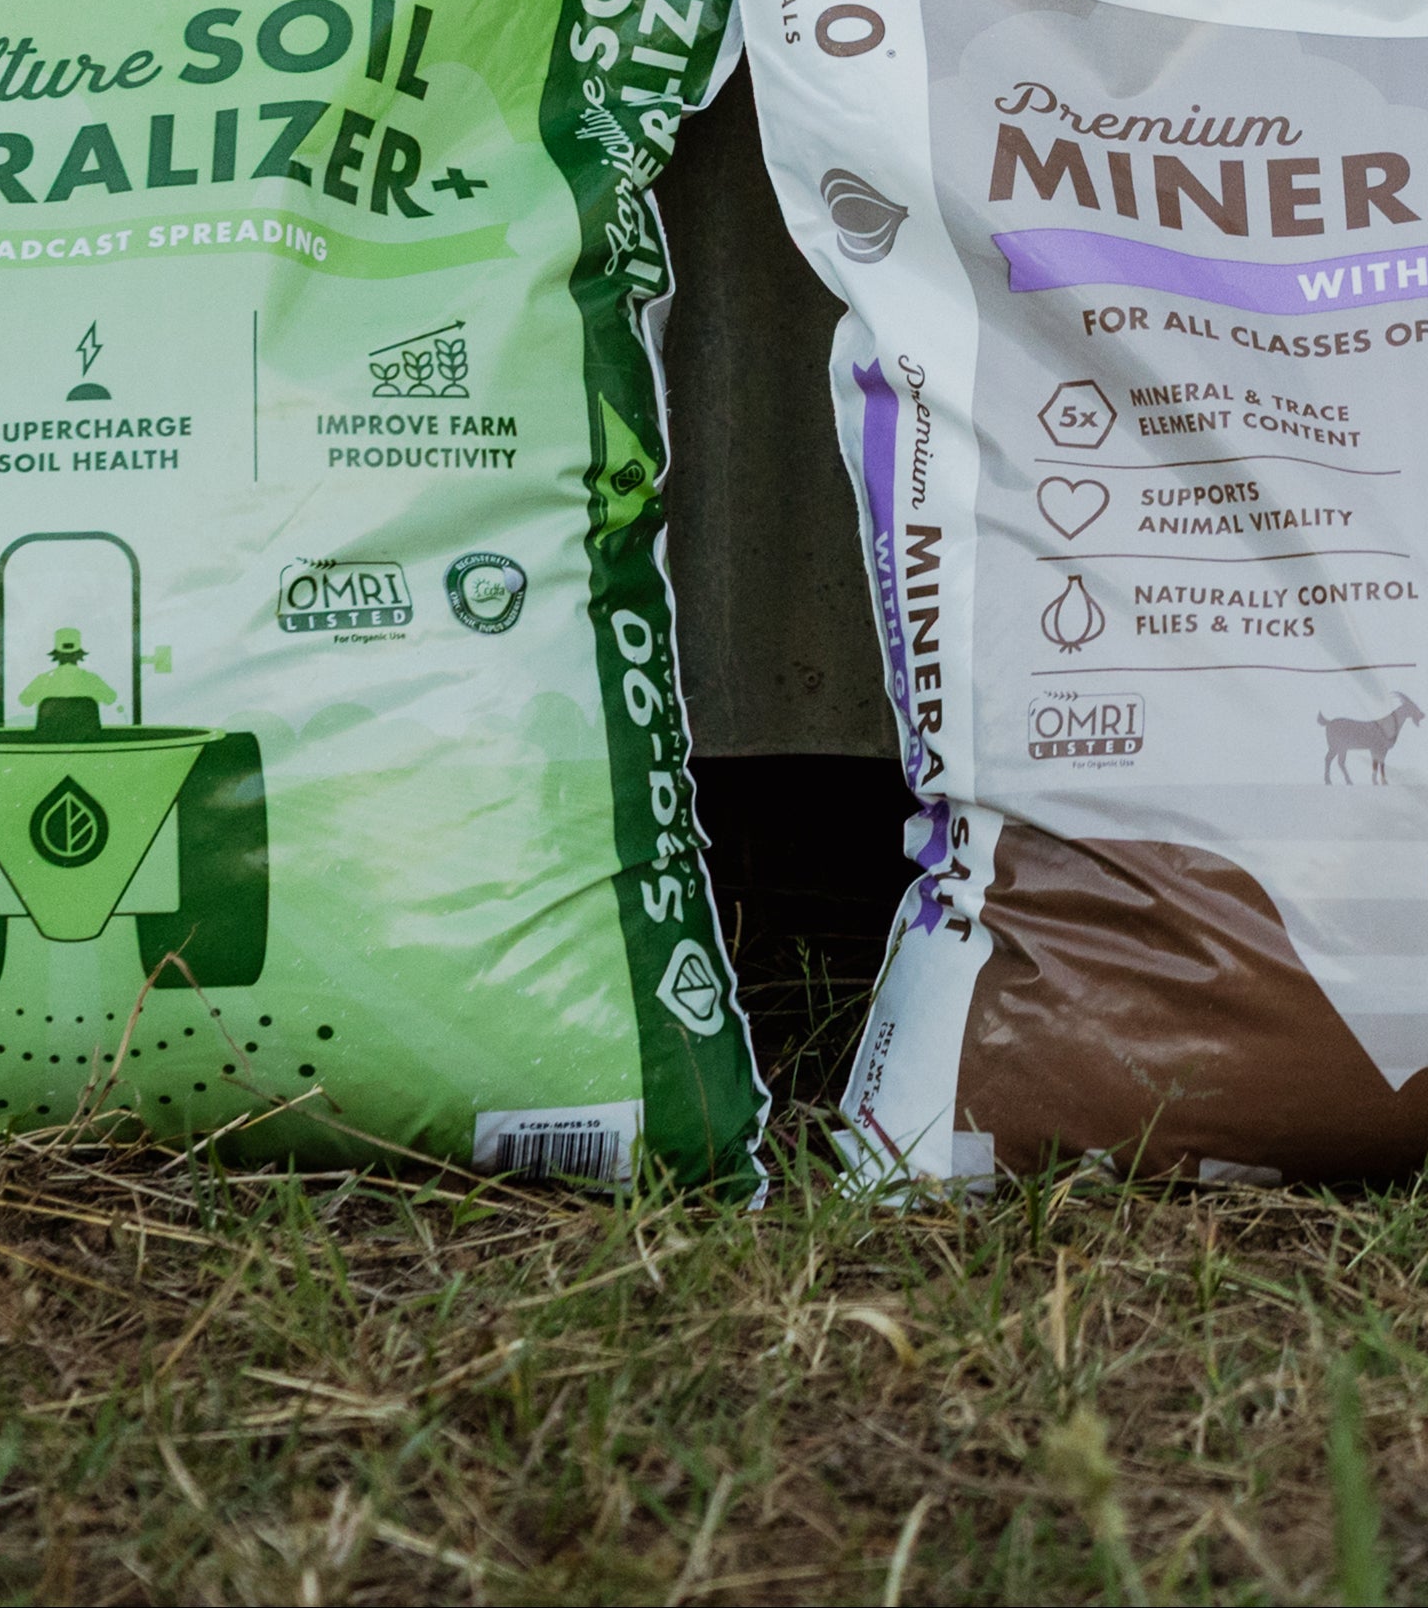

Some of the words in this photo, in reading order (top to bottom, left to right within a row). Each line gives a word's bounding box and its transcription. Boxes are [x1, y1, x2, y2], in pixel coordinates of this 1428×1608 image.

[994, 81, 1303, 150] Premium
[147, 220, 329, 263] SPREADING
[1296, 257, 1428, 304] WITH
[1081, 307, 1150, 338] FOR
[1161, 310, 1221, 342] ALL
[1230, 326, 1373, 360] CLASSES
[1058, 405, 1099, 429] 5x
[1129, 384, 1234, 407] MINERAL
[1244, 389, 1262, 406] &
[1271, 395, 1350, 423] TRACE
[315, 415, 441, 438] IMPROVE
[449, 414, 519, 438] FARM
[897, 354, 936, 510] Premium
[1138, 409, 1232, 437] ELEMENT
[1242, 412, 1361, 448] CONTENT
[72, 447, 180, 472] HEALTH
[327, 446, 518, 470] PRODUCTIVITY
[1140, 481, 1260, 507] SUPPORTS
[1138, 515, 1244, 536] ANIMAL
[1249, 508, 1353, 532] VITALITY
[287, 572, 403, 610] OMRI
[873, 531, 901, 649] WITH
[1134, 584, 1287, 609] NATURALLY
[1297, 580, 1419, 606] CONTROL
[286, 609, 406, 632] LISTED
[1136, 614, 1199, 635] FLIES
[1210, 614, 1229, 634] &
[1241, 617, 1316, 638] TICKS
[905, 524, 945, 788] MINERA
[1035, 703, 1137, 738] OMRI
[1035, 739, 1136, 757] LISTED
